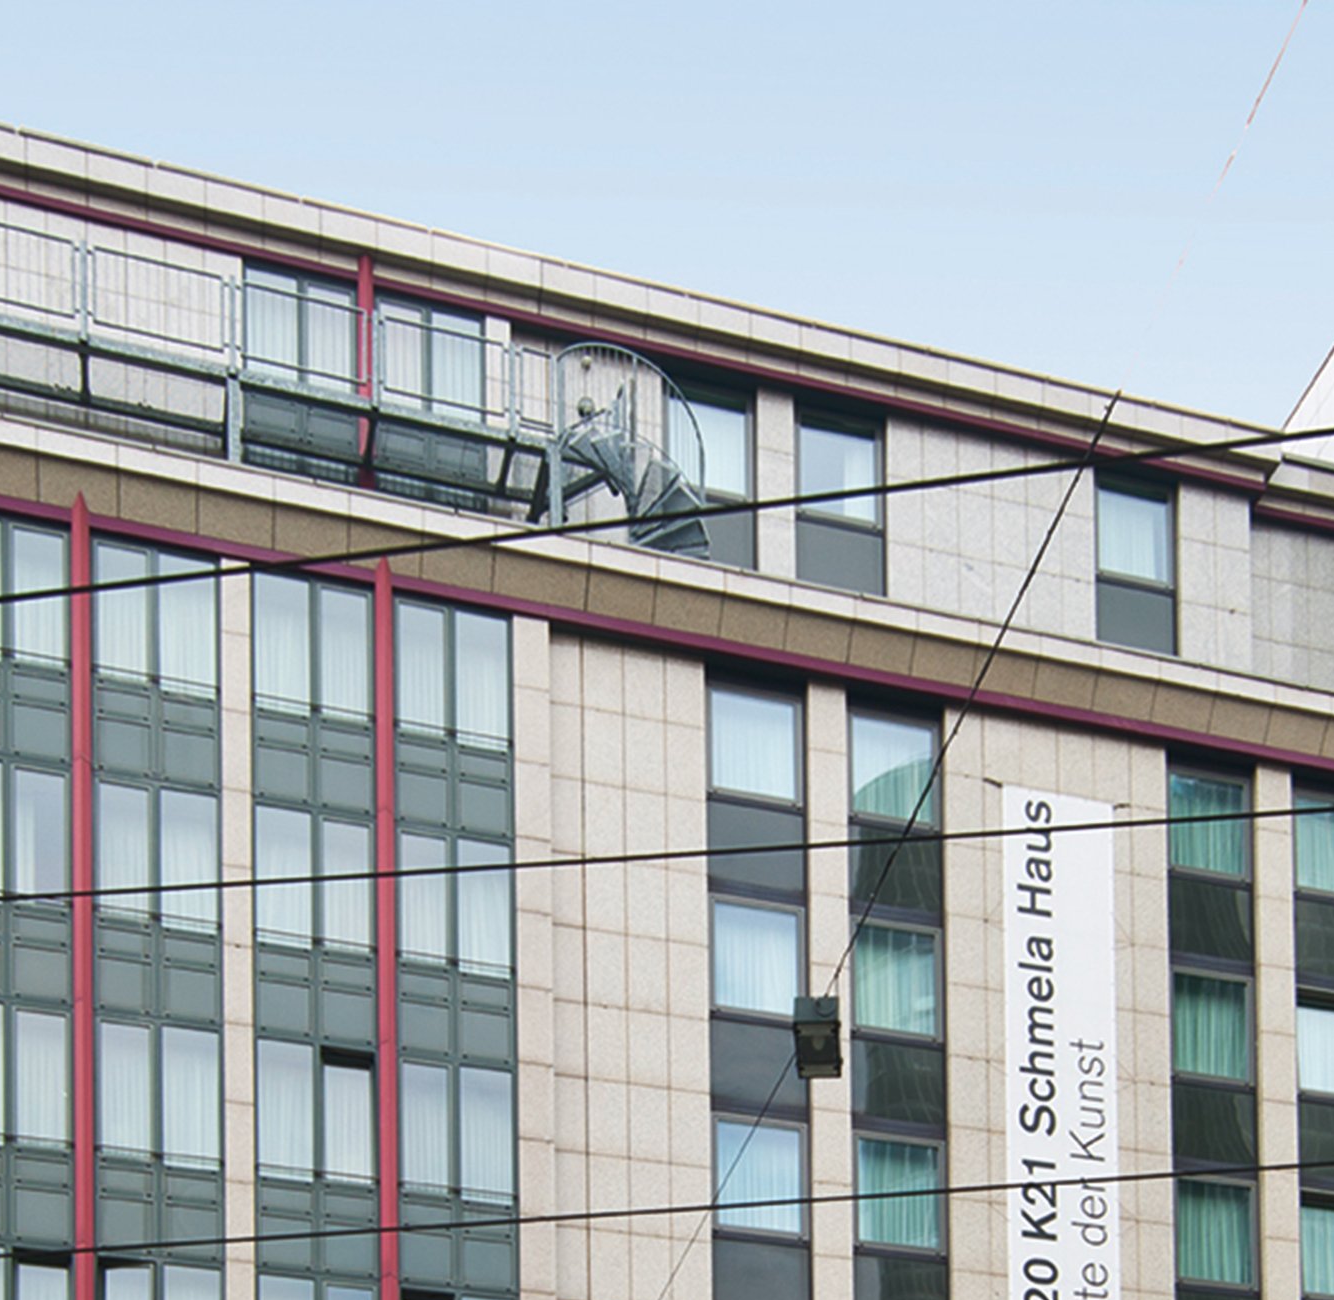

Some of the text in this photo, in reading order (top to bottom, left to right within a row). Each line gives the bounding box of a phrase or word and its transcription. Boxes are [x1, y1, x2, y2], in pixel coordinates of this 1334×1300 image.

[1016, 799, 1054, 918] Haus
[1017, 935, 1057, 1137] Schmela
[1068, 1037, 1107, 1162] Kunst
[1021, 1158, 1058, 1242] K21
[1070, 1177, 1109, 1247] der
